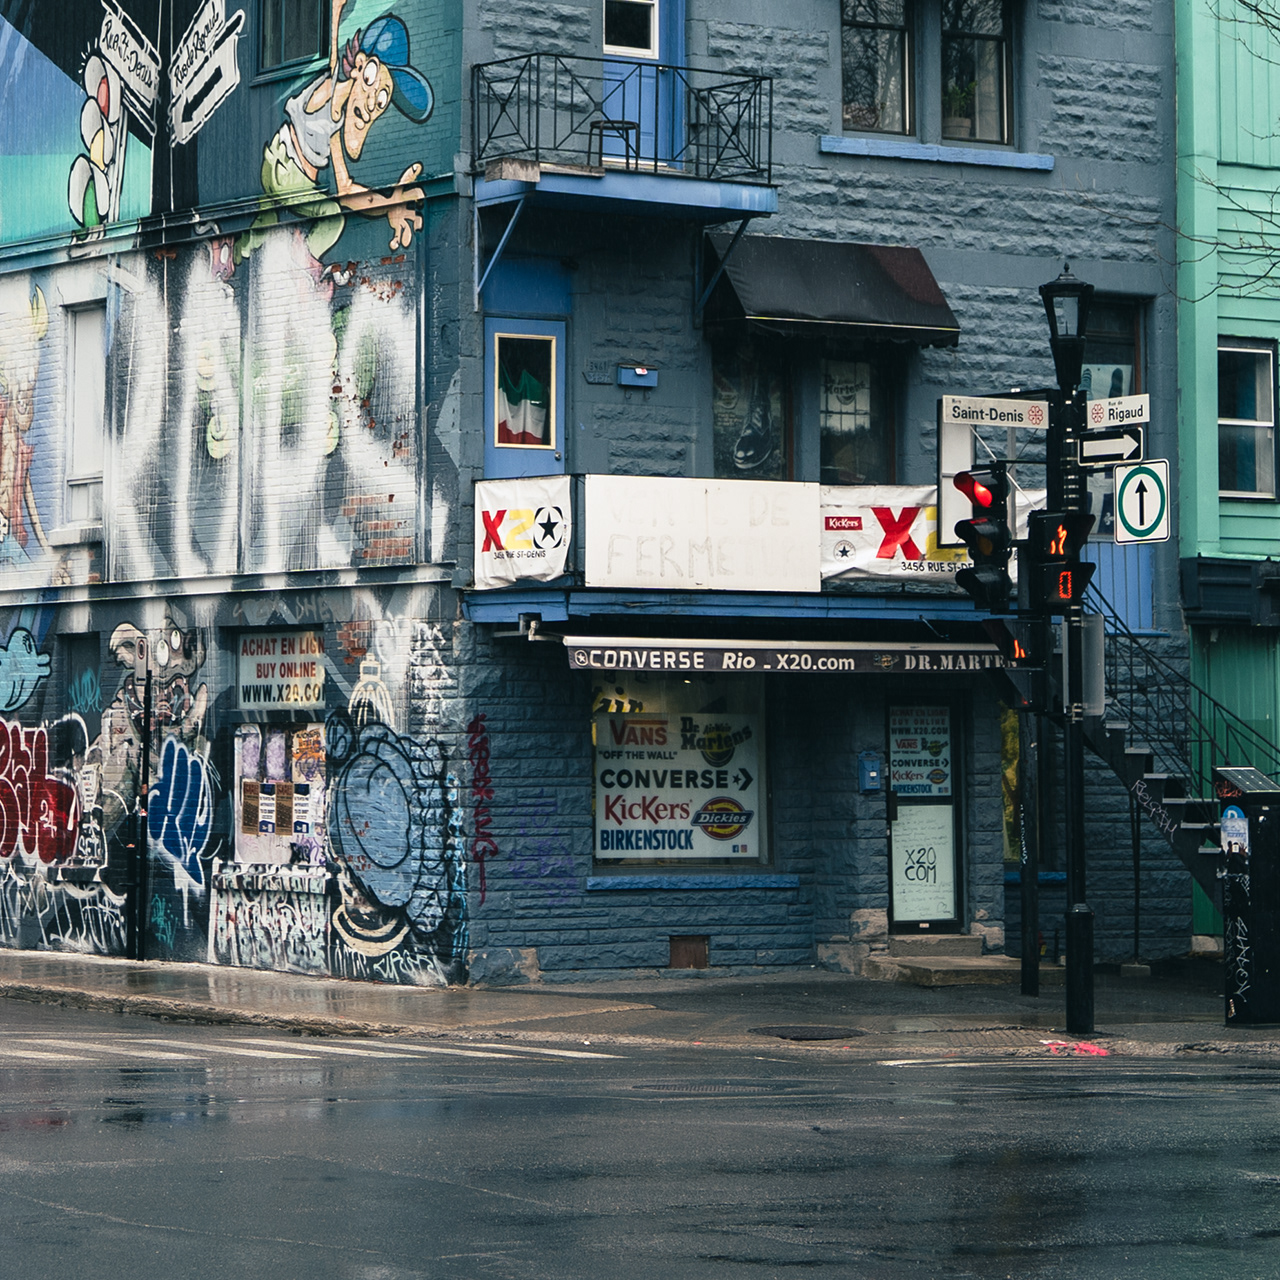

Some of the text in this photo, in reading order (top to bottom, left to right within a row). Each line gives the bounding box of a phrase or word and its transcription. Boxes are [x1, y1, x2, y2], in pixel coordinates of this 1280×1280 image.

[952, 405, 1024, 422] Saint-Denis
[1108, 404, 1143, 422] Rigaud
[749, 491, 792, 527] DE
[517, 550, 546, 558] ST-DENIS
[901, 561, 974, 572] 3456 RUE ST-DE
[241, 636, 325, 656] ACHAT EN LIGN
[589, 650, 705, 669] CONVERSE
[722, 652, 756, 669] Rio
[776, 654, 855, 670] X20.com
[256, 661, 316, 678] BUY ONLINE
[609, 720, 669, 746] VANS
[680, 725, 753, 750] Martens
[891, 727, 948, 735] WWW.X20.COM
[895, 739, 918, 749] VANS
[627, 751, 645, 760] THE
[891, 759, 940, 767] CONVERSE
[600, 769, 729, 789] CONVERSE
[893, 785, 933, 794] BIRKENSTOCK
[698, 813, 746, 823] Dickies
[600, 829, 694, 850] BIRKENSTOCK
[905, 847, 937, 865] X20
[905, 865, 937, 884] COM
